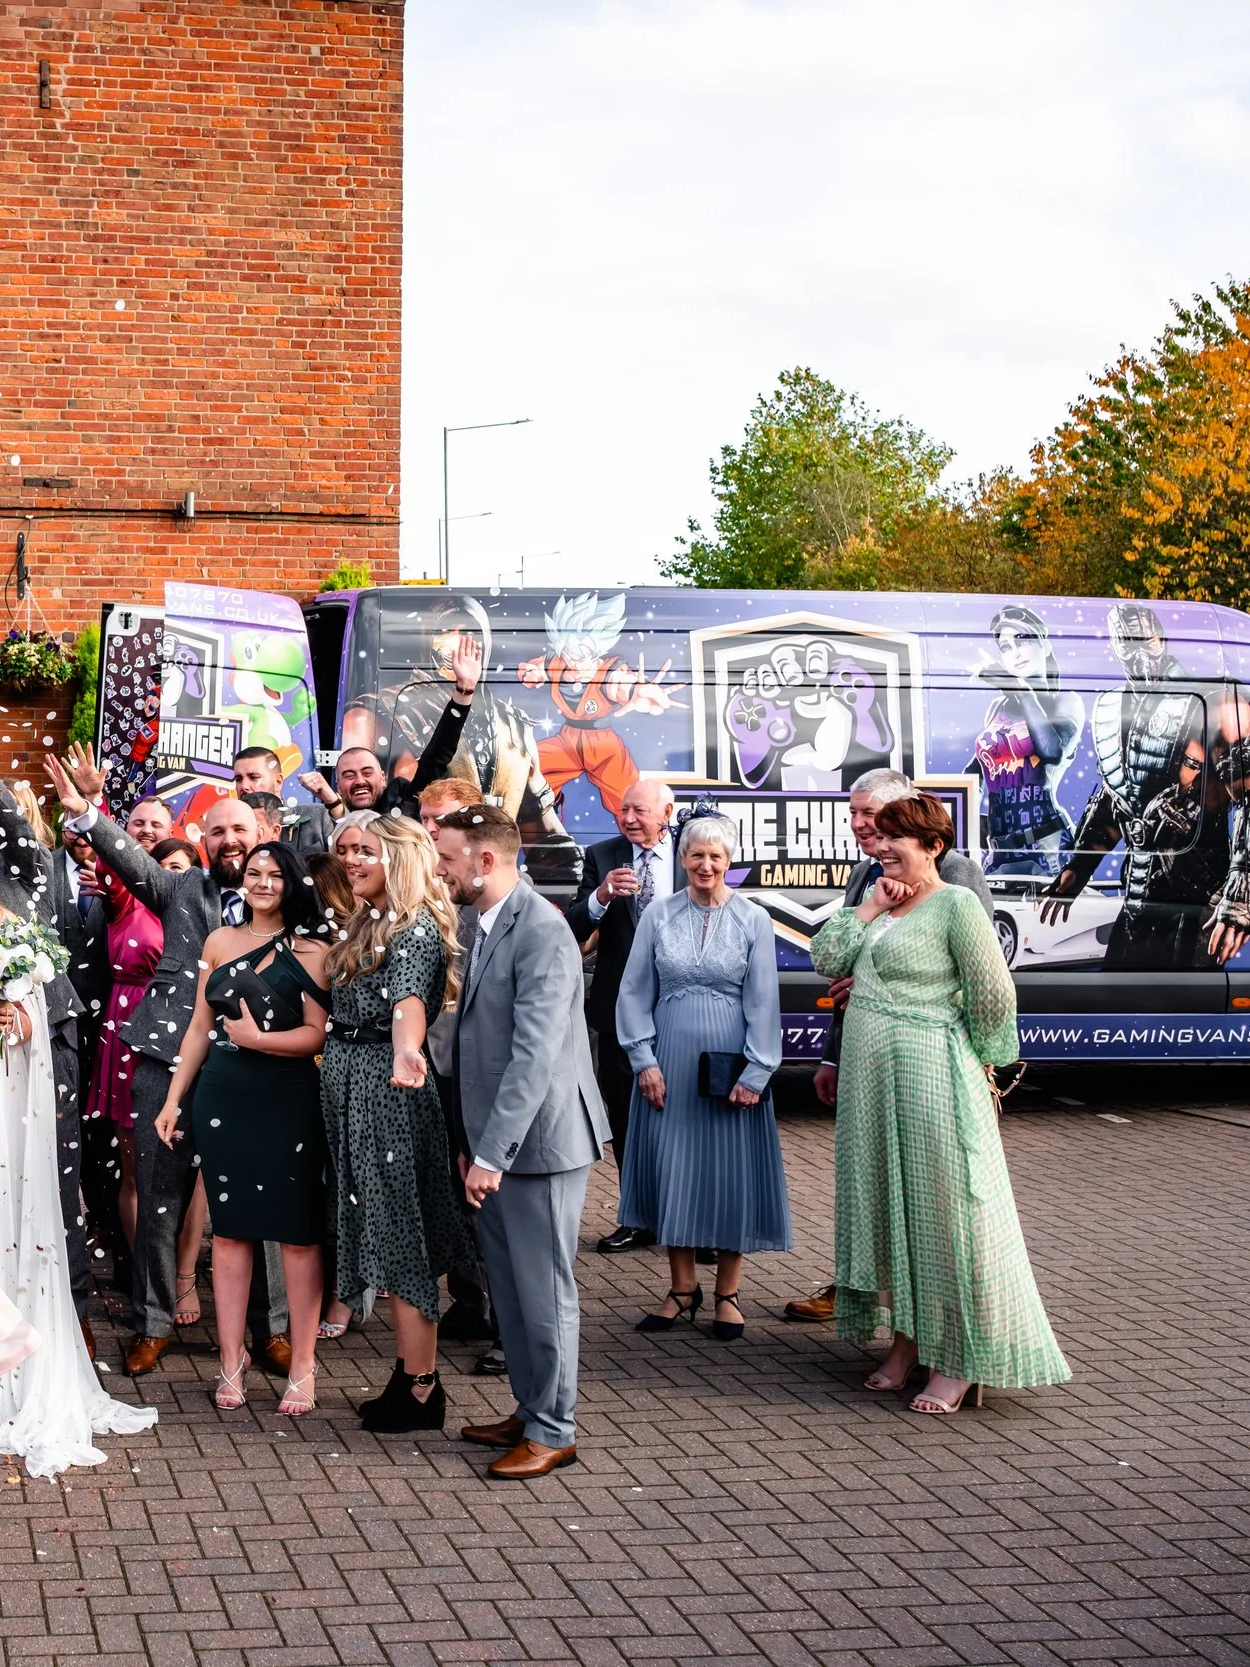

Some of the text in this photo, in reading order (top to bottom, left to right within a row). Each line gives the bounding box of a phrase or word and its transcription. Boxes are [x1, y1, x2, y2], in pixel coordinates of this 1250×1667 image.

[167, 756, 186, 770] VAN
[786, 801, 869, 862] CHA
[760, 864, 828, 887] GAMING
[781, 1028, 824, 1043] 77
